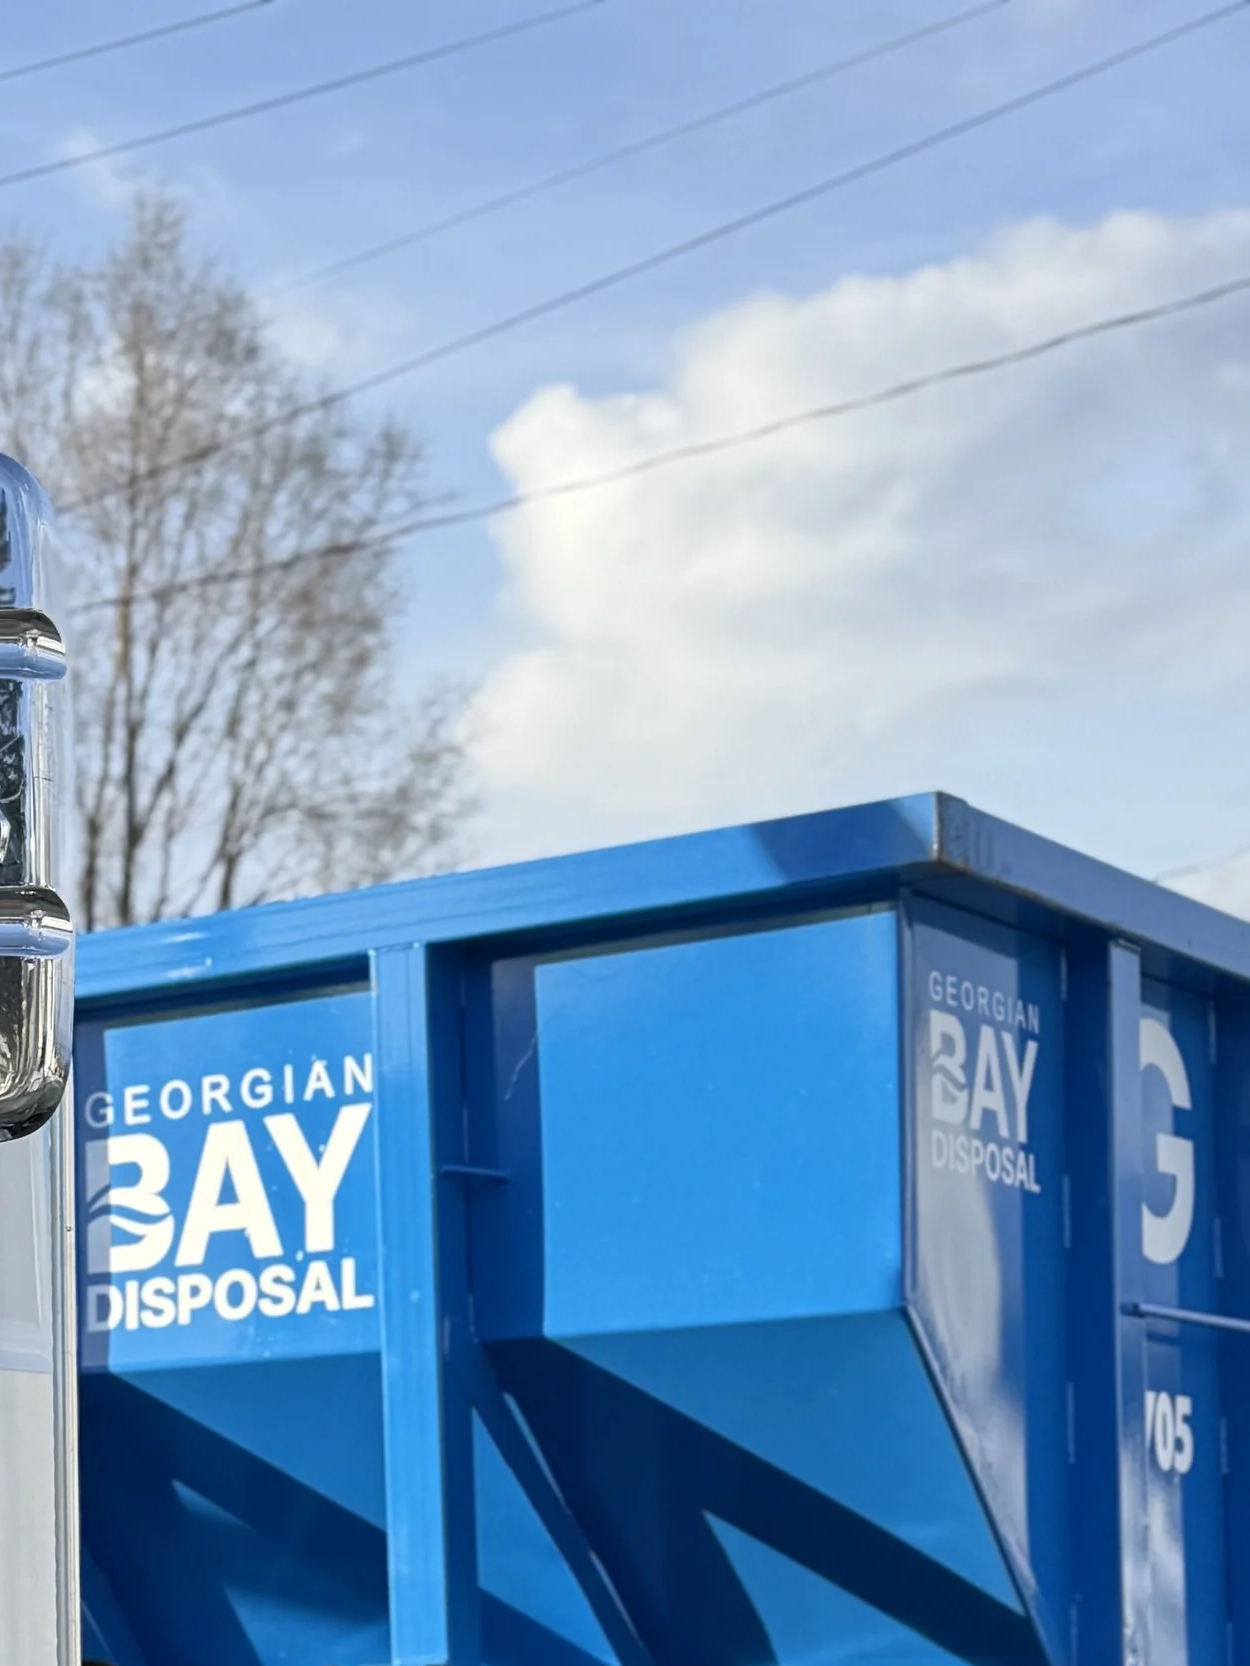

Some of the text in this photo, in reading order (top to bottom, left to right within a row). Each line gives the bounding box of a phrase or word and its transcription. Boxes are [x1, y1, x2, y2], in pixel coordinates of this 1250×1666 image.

[928, 969, 1040, 1035] GEORGIAN
[84, 1052, 375, 1129] GEORGIAN
[929, 1008, 1039, 1145] BAY
[84, 1101, 374, 1275] BAY
[930, 1128, 1042, 1195] DISPOSAL
[85, 1256, 376, 1334] DISPOSAL
